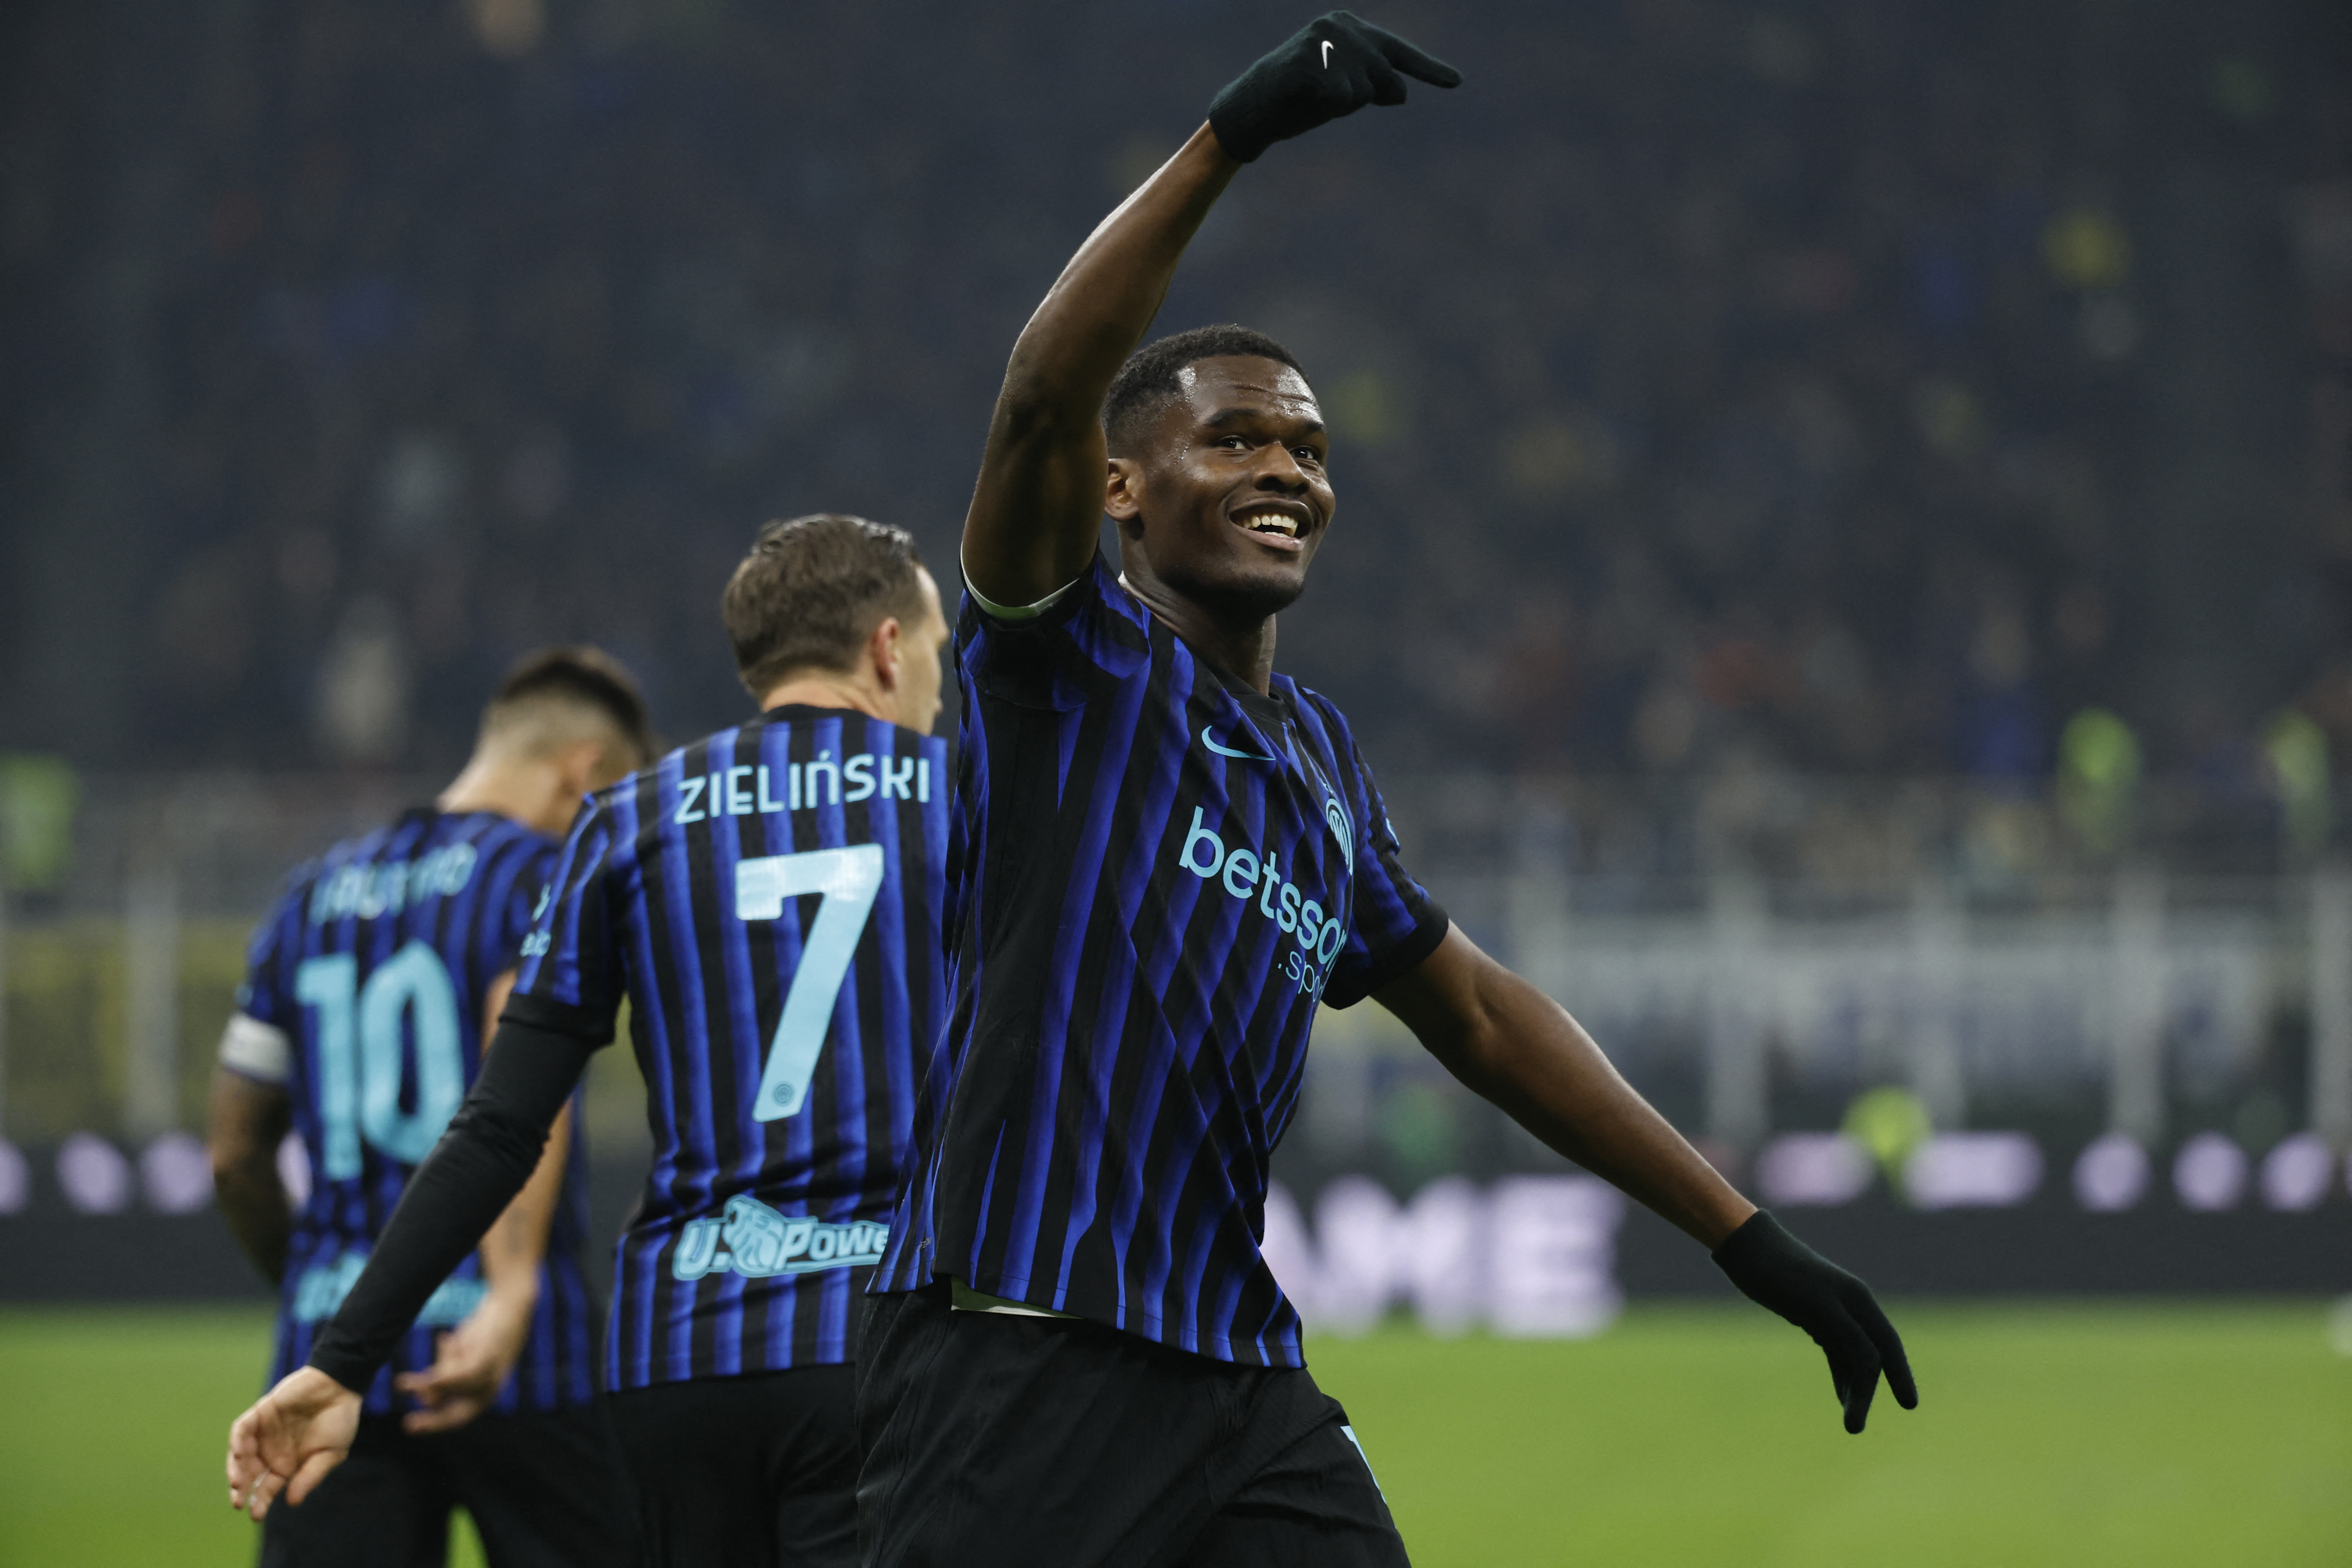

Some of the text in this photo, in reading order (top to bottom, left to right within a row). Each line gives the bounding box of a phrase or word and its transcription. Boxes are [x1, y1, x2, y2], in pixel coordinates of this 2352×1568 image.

[674, 749, 930, 825] ZIELIŃSKI
[296, 939, 463, 1180] 10
[734, 843, 884, 1123] 7
